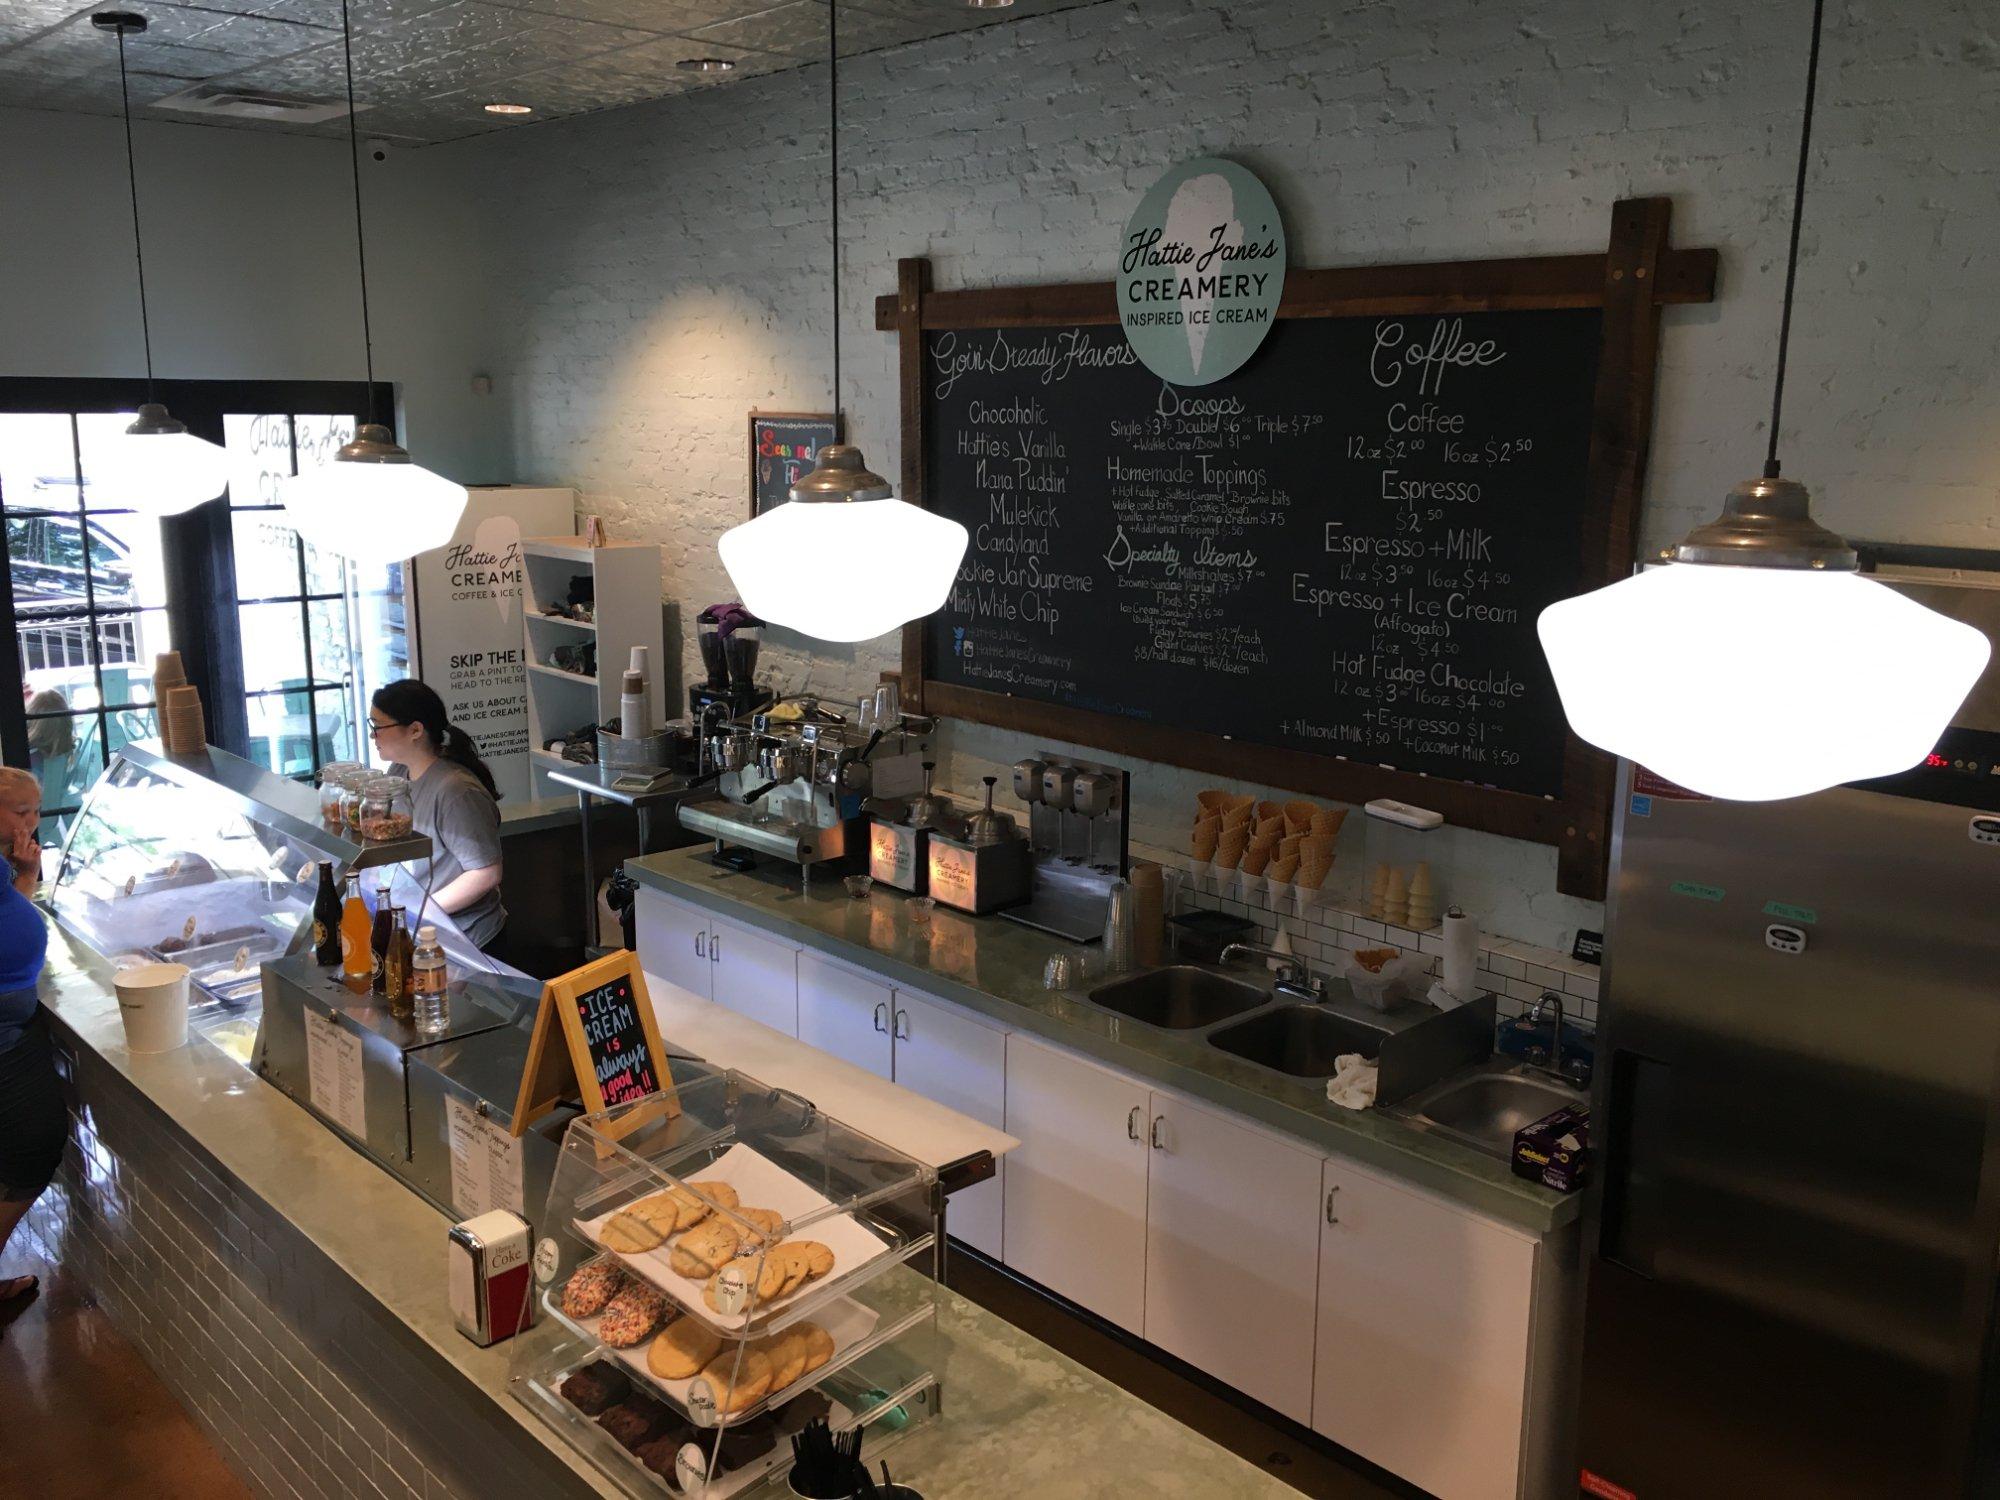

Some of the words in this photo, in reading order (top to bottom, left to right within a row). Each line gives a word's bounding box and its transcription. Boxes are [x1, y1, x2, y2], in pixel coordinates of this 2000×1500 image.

[1122, 227, 1196, 275] Hattie
[1196, 223, 1280, 273] Jane's
[1128, 272, 1269, 303] CREAMERY
[1127, 311, 1184, 327] INSPIRED
[1189, 310, 1210, 324] ICE
[1216, 307, 1268, 324] CREAM
[984, 328, 1061, 385] Steady
[1056, 327, 1138, 381] Flavors
[1370, 317, 1508, 396] Coffee
[969, 396, 1049, 425] Chocoholic
[1155, 380, 1245, 431] Scoops
[1387, 402, 1465, 434] Coffee
[1018, 430, 1067, 459] Vanilla
[1110, 416, 1142, 441] Single
[1175, 415, 1218, 434] Double
[1256, 414, 1287, 444] Triple
[976, 457, 1013, 490] Nana
[1106, 455, 1194, 484] Homemade
[1194, 454, 1267, 499] Toppings
[1381, 469, 1480, 512] Espresso
[990, 493, 1060, 529] Mulekick
[444, 543, 498, 571] Hattie
[976, 523, 1051, 566] Candyland
[1102, 524, 1180, 577] Specialty
[1193, 536, 1258, 569] Items
[1324, 521, 1424, 564] Espresso
[999, 556, 1028, 588] Jar
[1028, 555, 1094, 598] Supreme
[451, 591, 488, 601] COFFEE
[491, 590, 499, 599] &
[500, 588, 515, 598] ICE
[976, 586, 1018, 622] White
[1020, 590, 1061, 636] Chip
[1292, 571, 1385, 618] Espresso
[1407, 587, 1442, 617] Ice
[1446, 592, 1518, 624] Cream
[1374, 611, 1451, 646] (Affogato)
[450, 653, 482, 669] SKIP
[487, 649, 516, 665] THE
[450, 671, 476, 680] GRAB
[487, 667, 507, 675] PINT
[512, 664, 523, 673] TO
[1332, 649, 1367, 679] Hot
[1371, 655, 1427, 692] Fudge
[1430, 662, 1526, 698] Chocolate
[450, 681, 477, 690] HEAD
[480, 679, 492, 687] TO
[495, 677, 512, 685] THE
[452, 702, 469, 711] ASK
[473, 700, 484, 709] US
[487, 697, 516, 707] ABOUT
[452, 714, 471, 723] AND
[473, 711, 488, 720] ICE
[490, 708, 520, 718] CREAM
[1294, 719, 1338, 742] Almond
[1340, 723, 1363, 744] Milk
[1462, 746, 1486, 763] Milk
[584, 985, 617, 1019] ICE
[584, 1003, 634, 1047] CREAM
[595, 1043, 646, 1083] always
[607, 1068, 633, 1104] good
[491, 1248, 522, 1269] Coke
